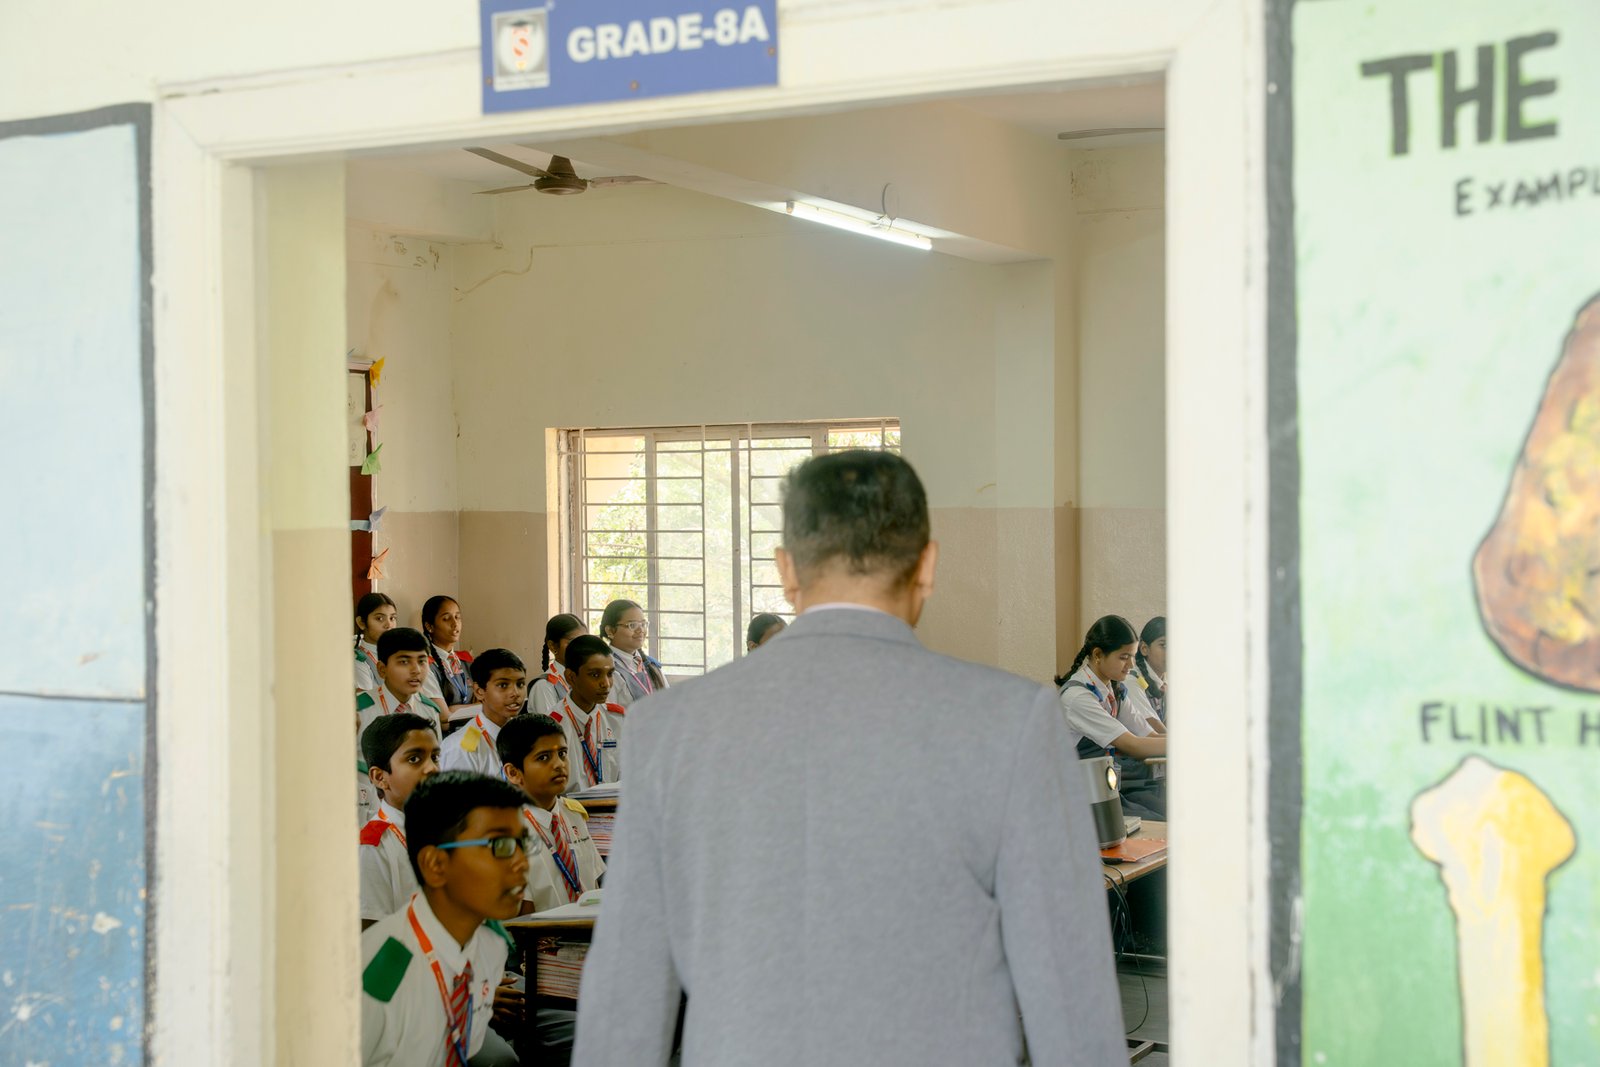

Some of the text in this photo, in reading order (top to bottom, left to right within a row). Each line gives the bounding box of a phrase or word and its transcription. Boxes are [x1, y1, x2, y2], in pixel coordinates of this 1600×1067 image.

[567, 6, 769, 63] GRADE-8A
[1359, 30, 1558, 156] THE
[1421, 702, 1553, 746] FLINT
